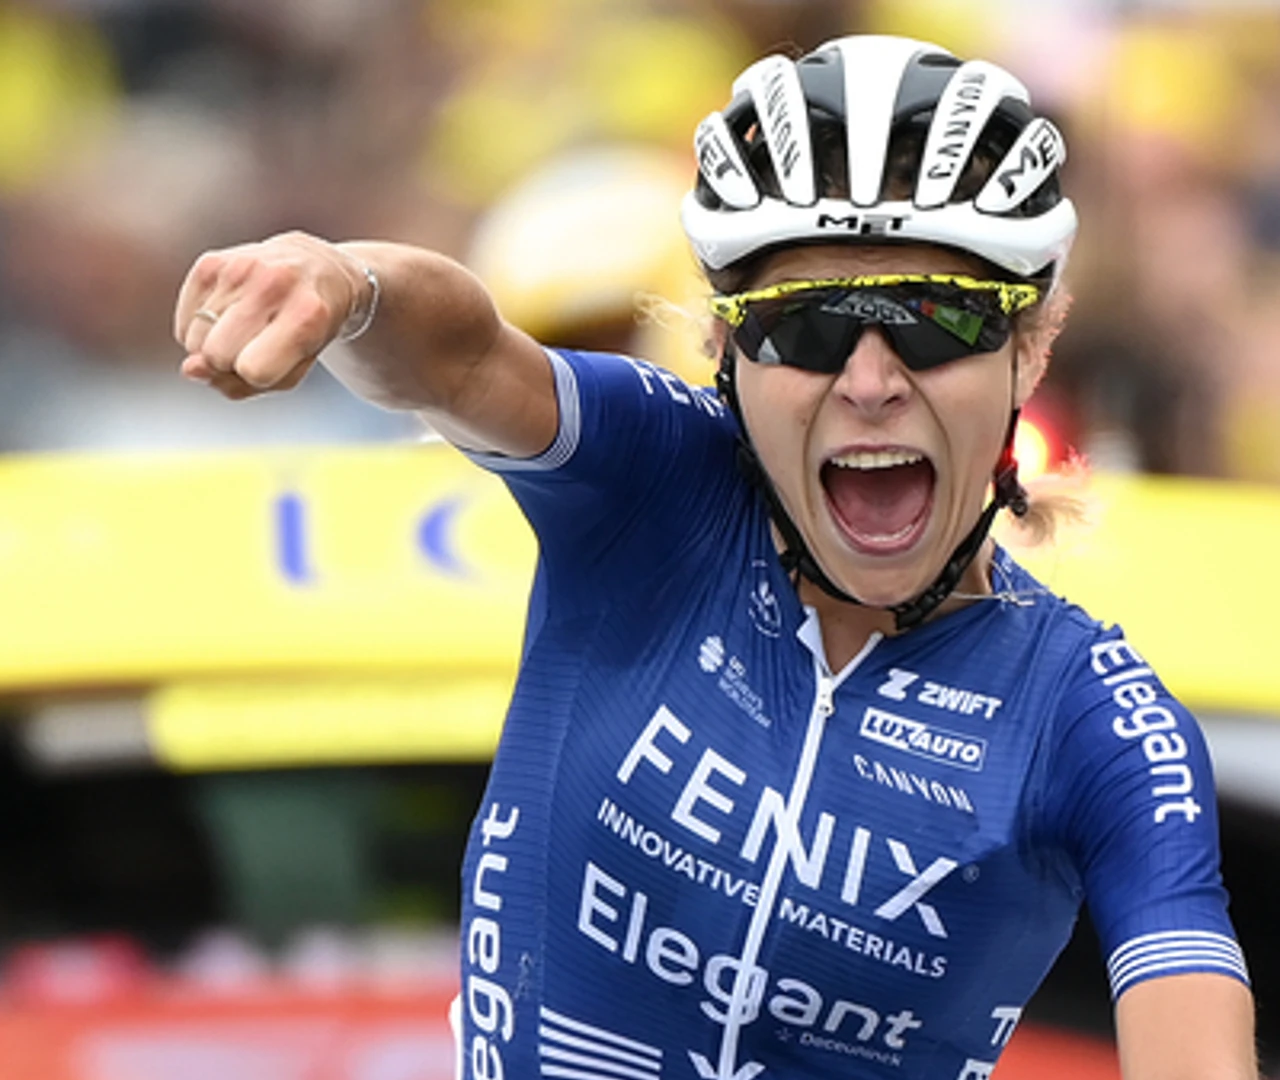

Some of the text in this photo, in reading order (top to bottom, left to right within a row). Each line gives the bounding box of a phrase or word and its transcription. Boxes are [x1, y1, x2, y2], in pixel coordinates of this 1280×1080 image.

[817, 213, 912, 236] MET
[853, 754, 974, 814] CANYON
[917, 681, 1003, 720] ZWIFT
[1090, 639, 1202, 824] Elegant
[596, 797, 948, 979] INNOVATIVE MATERIALS
[616, 703, 960, 939] FENIX
[577, 860, 922, 1049] Elegant
